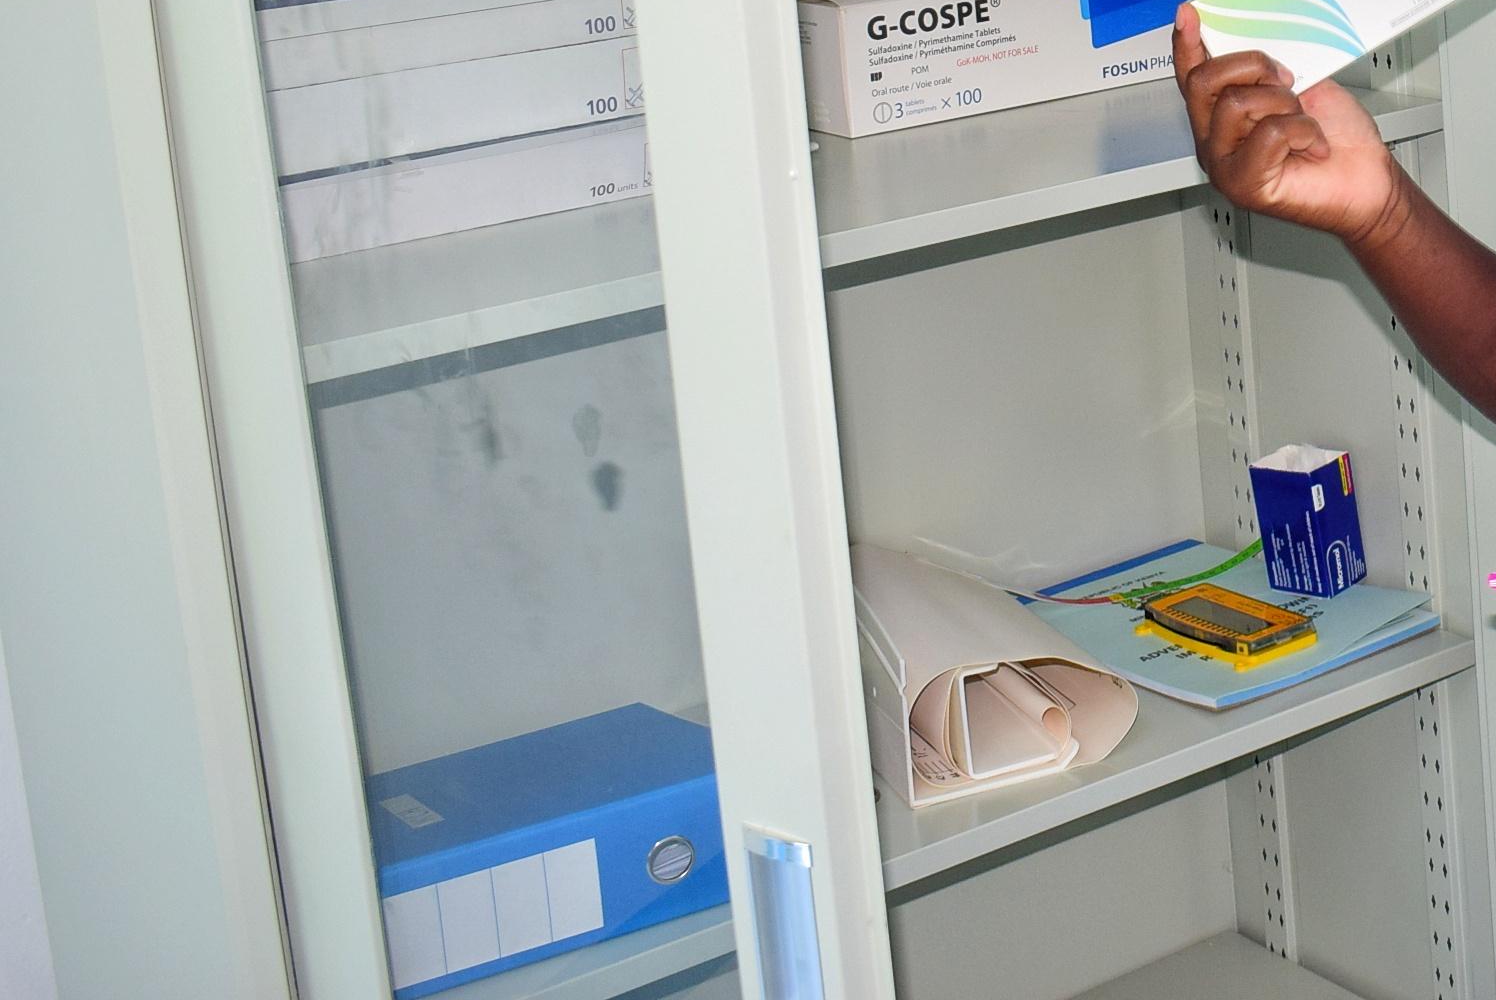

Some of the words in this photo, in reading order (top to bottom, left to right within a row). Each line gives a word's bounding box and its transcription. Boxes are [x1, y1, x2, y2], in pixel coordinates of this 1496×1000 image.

[584, 15, 616, 35] 100
[868, 43, 913, 57] Sulfadoxine
[919, 32, 974, 50] Pyrimethamine
[975, 26, 1001, 37] Tablets
[869, 53, 913, 67] Sulfadoxine
[975, 33, 1017, 49] Comprimés
[992, 51, 1007, 61] NOT
[1007, 48, 1022, 58] FOR
[1023, 44, 1039, 55] SALE
[911, 65, 930, 75] POM
[1102, 59, 1148, 79] FOSUN
[871, 85, 888, 98] Oral
[889, 85, 910, 95] route
[915, 79, 933, 89] Voie
[933, 76, 953, 87] orale
[586, 96, 618, 116] 100
[894, 102, 904, 119] 3
[955, 87, 982, 107] 100
[590, 182, 615, 198] 100
[616, 182, 639, 193] units
[1332, 547, 1345, 590] Micromol
